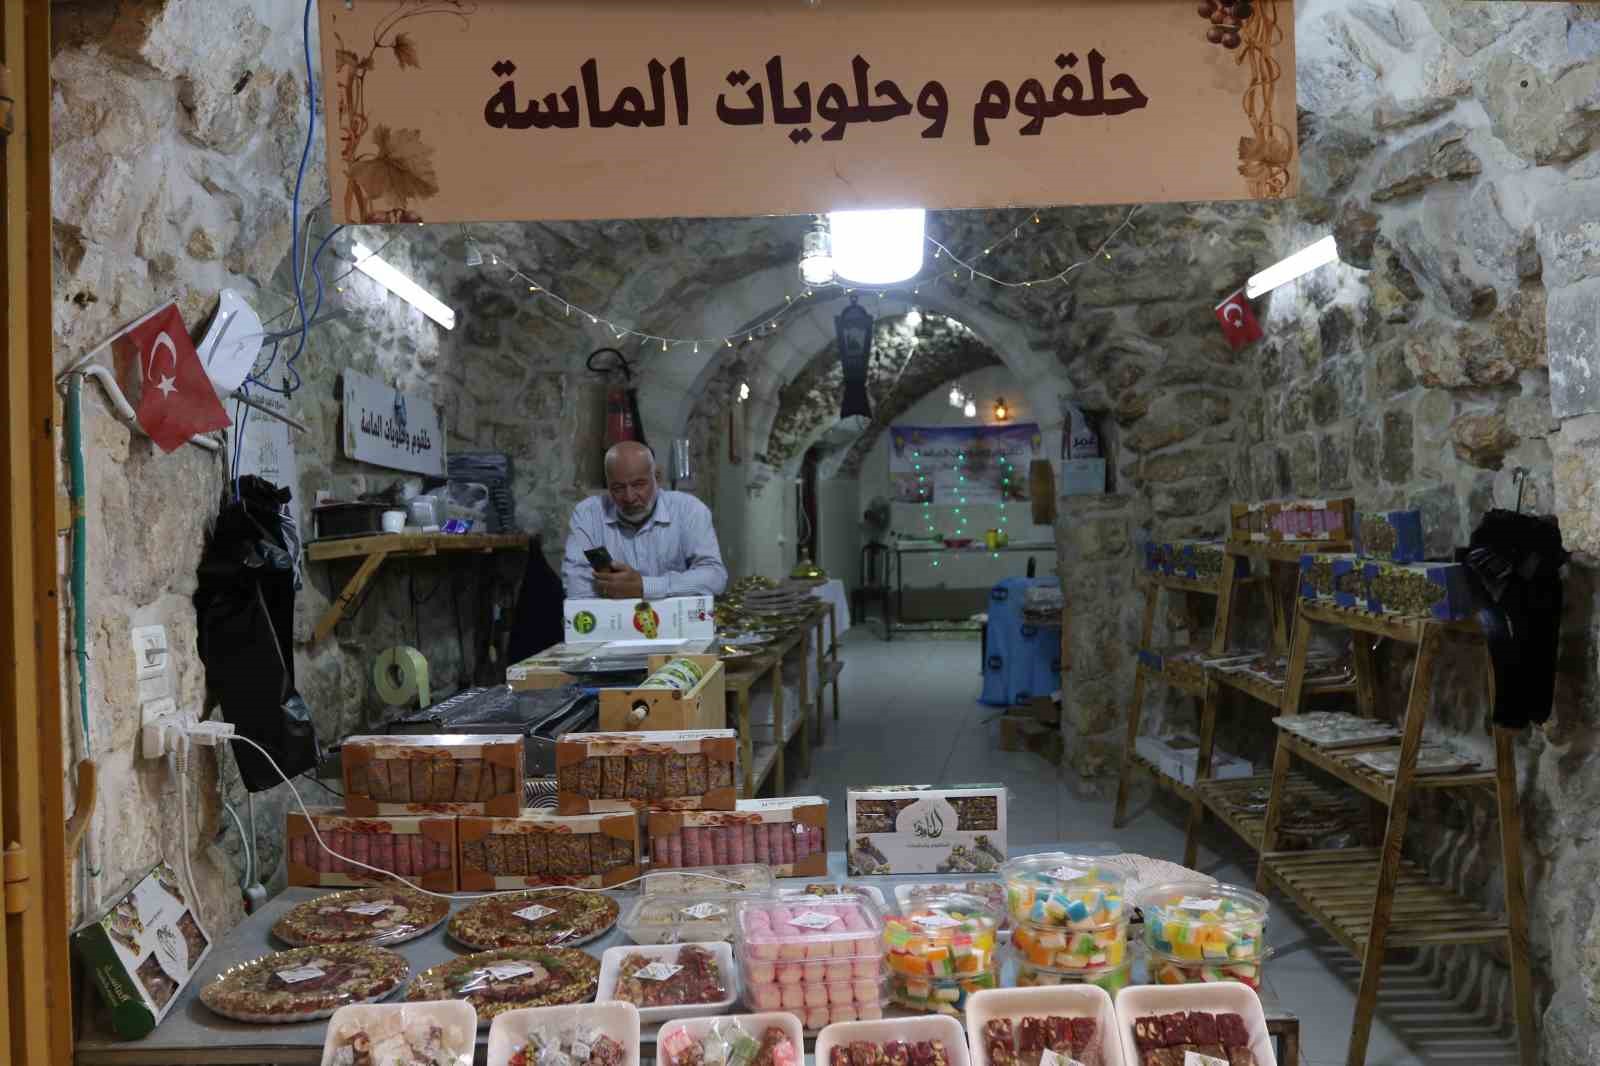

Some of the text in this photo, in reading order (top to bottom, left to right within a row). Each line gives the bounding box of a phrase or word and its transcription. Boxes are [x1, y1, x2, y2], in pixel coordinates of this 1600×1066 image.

[484, 48, 1149, 146] حلقوم وحلويات الماسة
